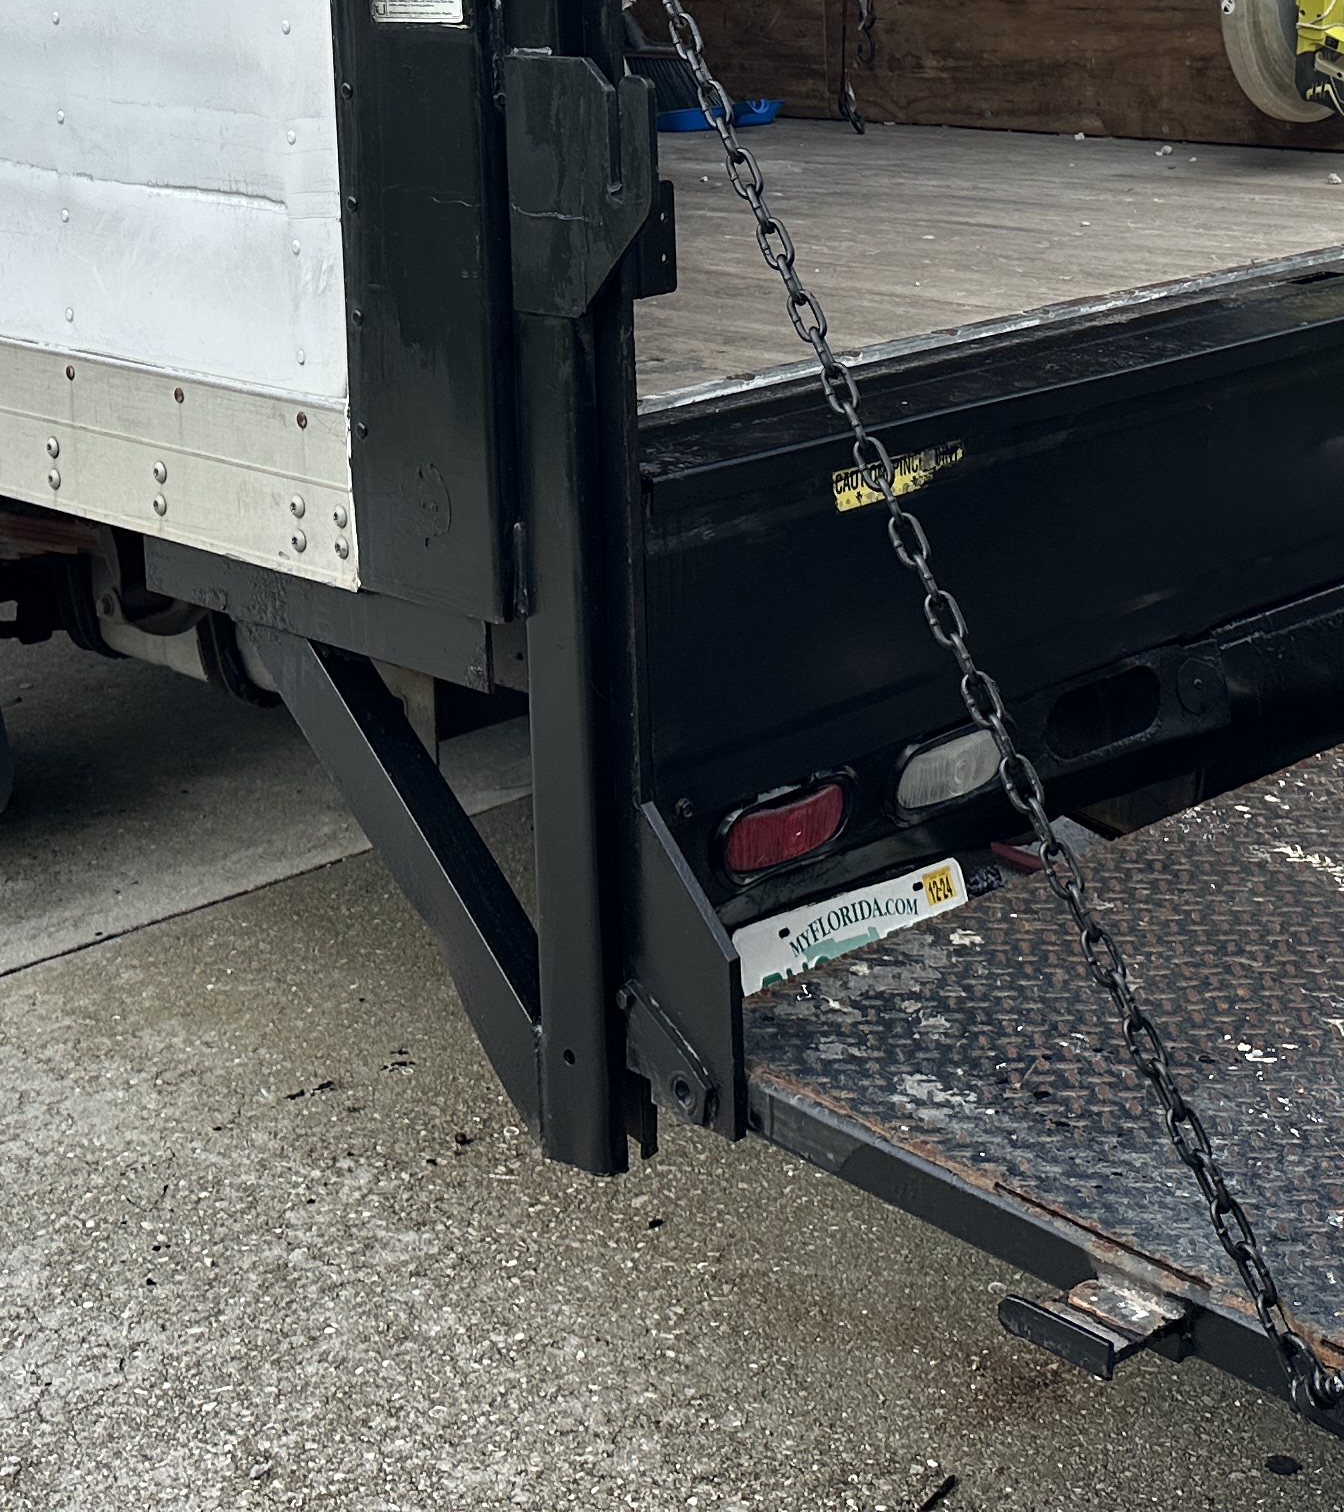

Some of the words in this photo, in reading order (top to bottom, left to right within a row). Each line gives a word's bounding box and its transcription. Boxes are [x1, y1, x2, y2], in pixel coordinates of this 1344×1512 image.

[835, 464, 888, 495] CAUTON
[928, 875, 954, 903] 12-24
[789, 897, 919, 958] MYFLORIDA.COM
